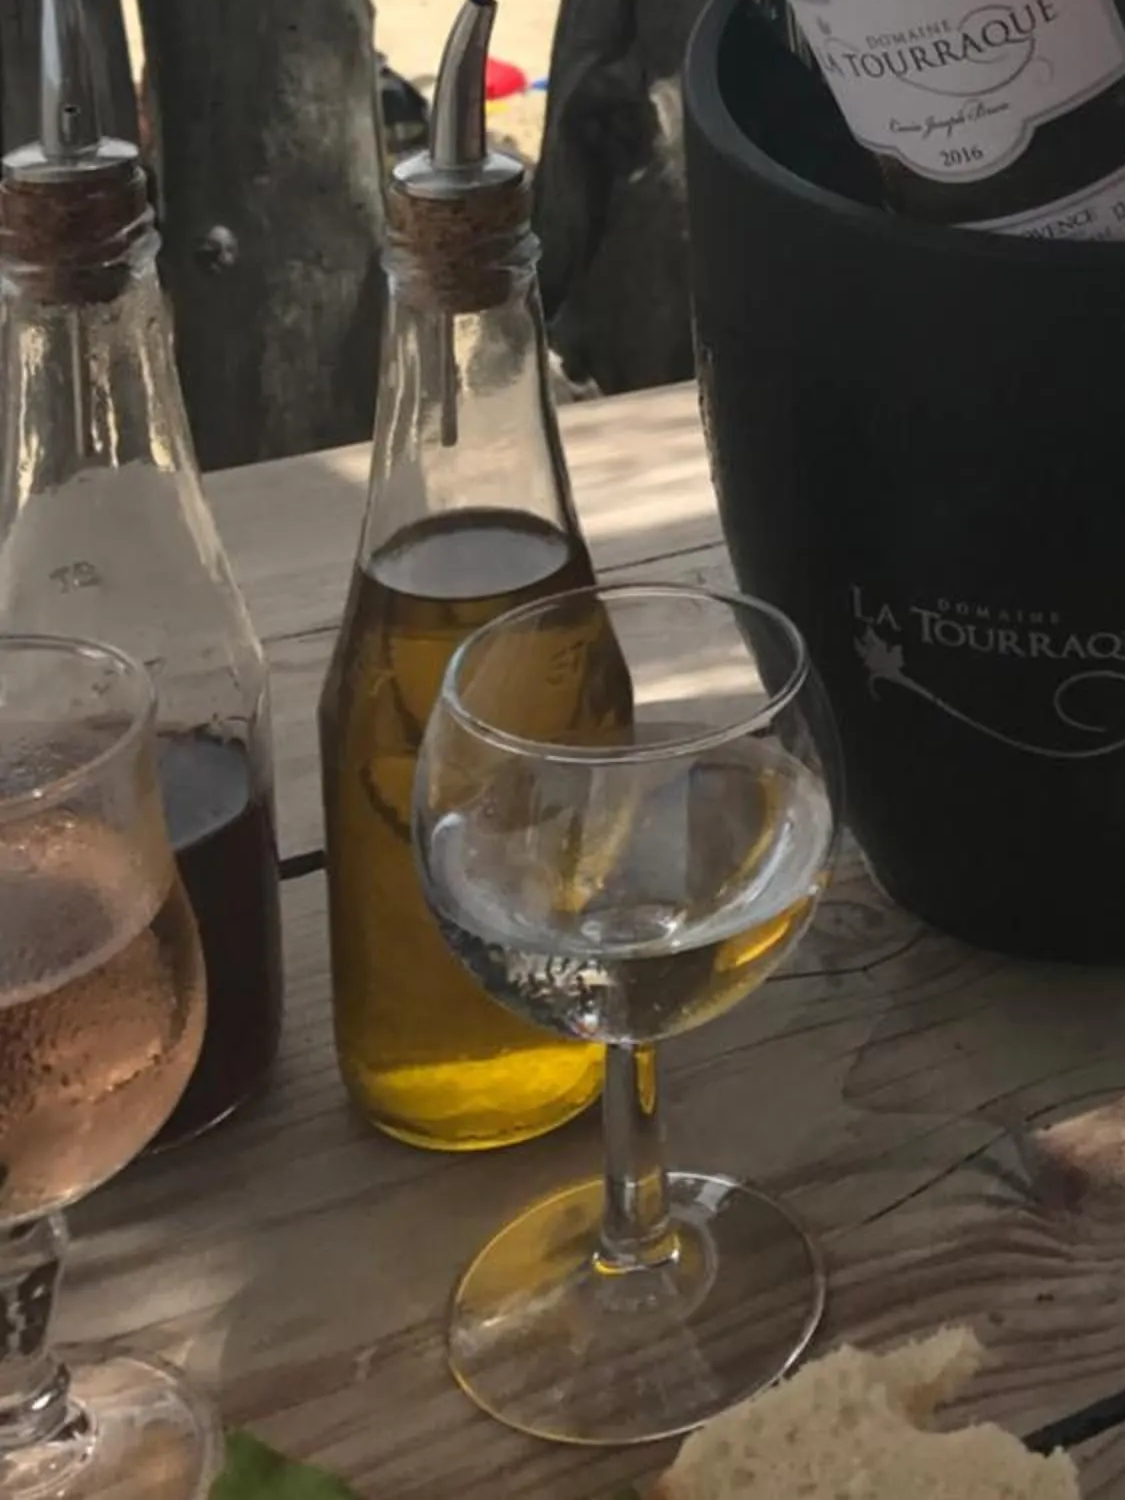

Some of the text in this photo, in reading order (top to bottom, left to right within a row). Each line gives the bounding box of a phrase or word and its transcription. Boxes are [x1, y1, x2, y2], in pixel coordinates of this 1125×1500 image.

[865, 20, 951, 51] DOMAINE
[939, 145, 985, 167] 2016
[849, 581, 903, 632] LA
[937, 597, 1062, 626] DOMAINE
